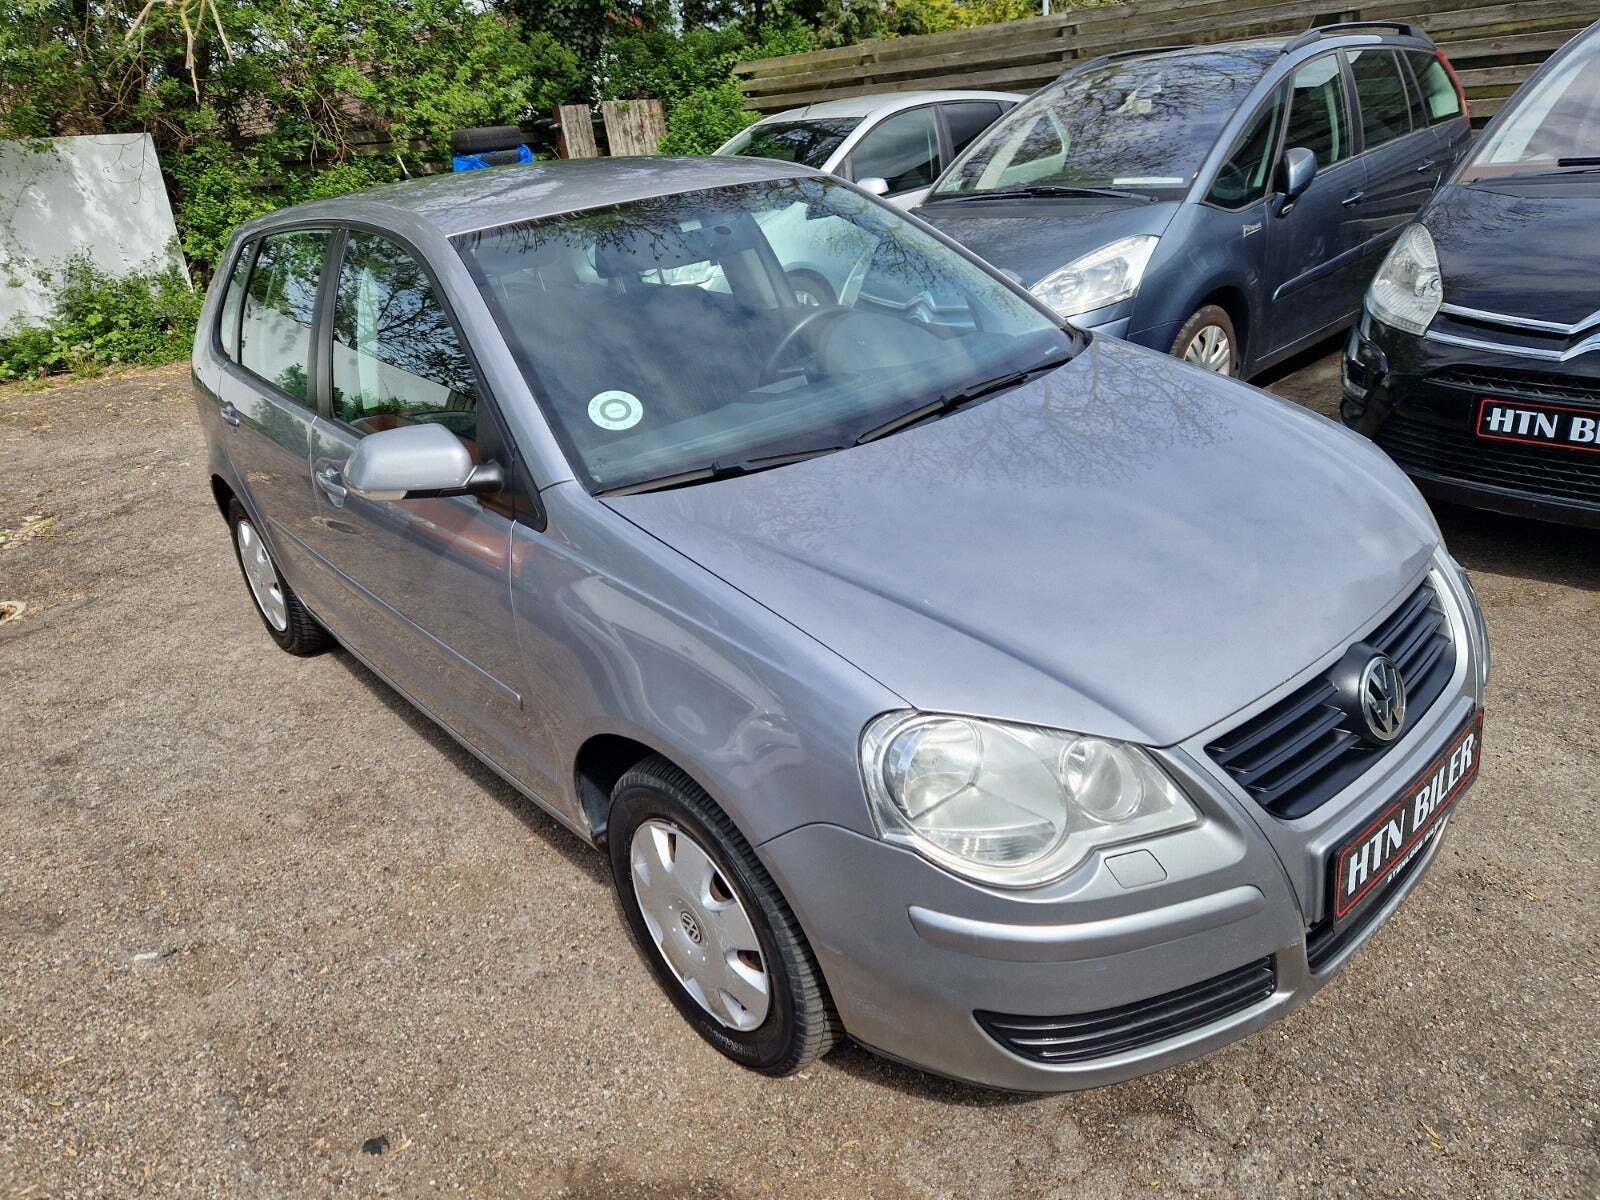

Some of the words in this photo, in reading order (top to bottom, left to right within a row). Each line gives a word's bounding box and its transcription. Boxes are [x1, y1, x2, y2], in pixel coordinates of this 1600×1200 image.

[1489, 407, 1559, 438] HTN
[1348, 808, 1406, 896] HTN
[1412, 733, 1475, 832] BILER
